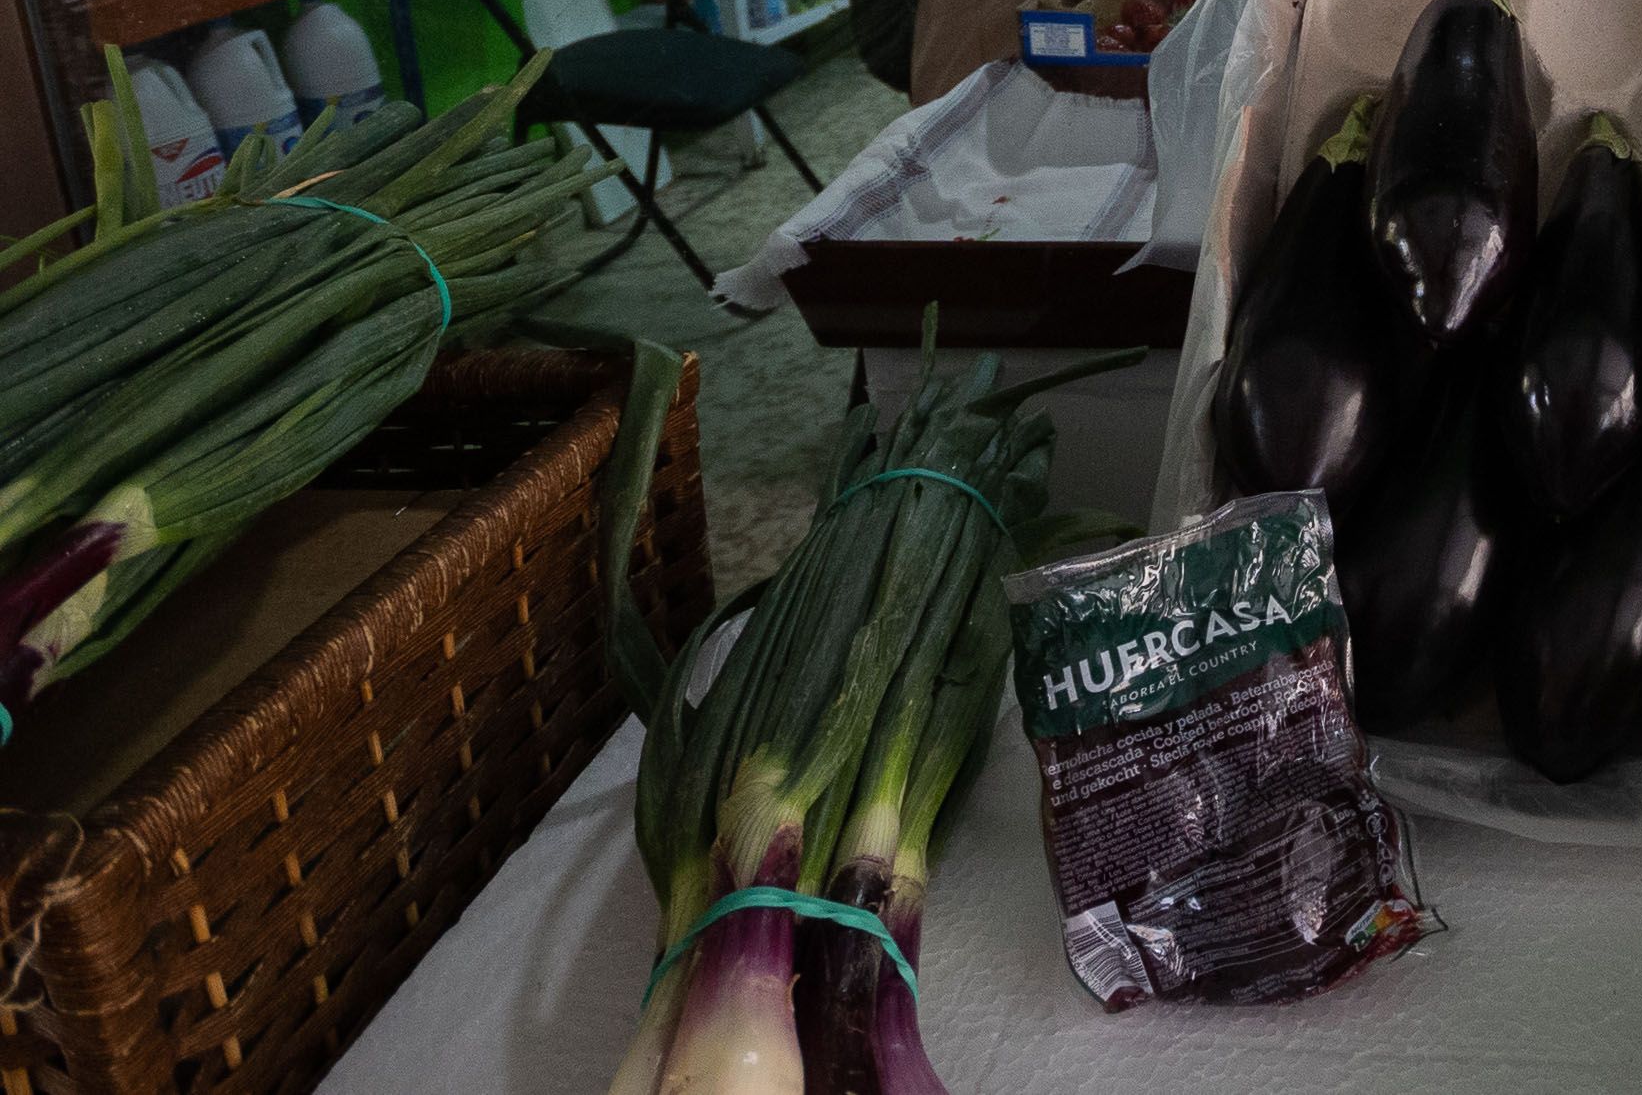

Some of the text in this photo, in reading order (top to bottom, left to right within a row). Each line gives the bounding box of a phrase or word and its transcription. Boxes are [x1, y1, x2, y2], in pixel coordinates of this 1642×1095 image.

[1043, 594, 1292, 711] HUERCASA
[1189, 640, 1257, 677] COUNTRY
[1117, 725, 1162, 750] cocida
[1164, 721, 1174, 735] y
[1176, 701, 1223, 731] pelada
[1230, 673, 1297, 706] Beterraba
[1050, 788, 1078, 807] und
[1081, 765, 1141, 799] gekocht
[1052, 778, 1063, 790] e
[1064, 745, 1144, 786] descascada
[1153, 723, 1205, 750] Cooked
